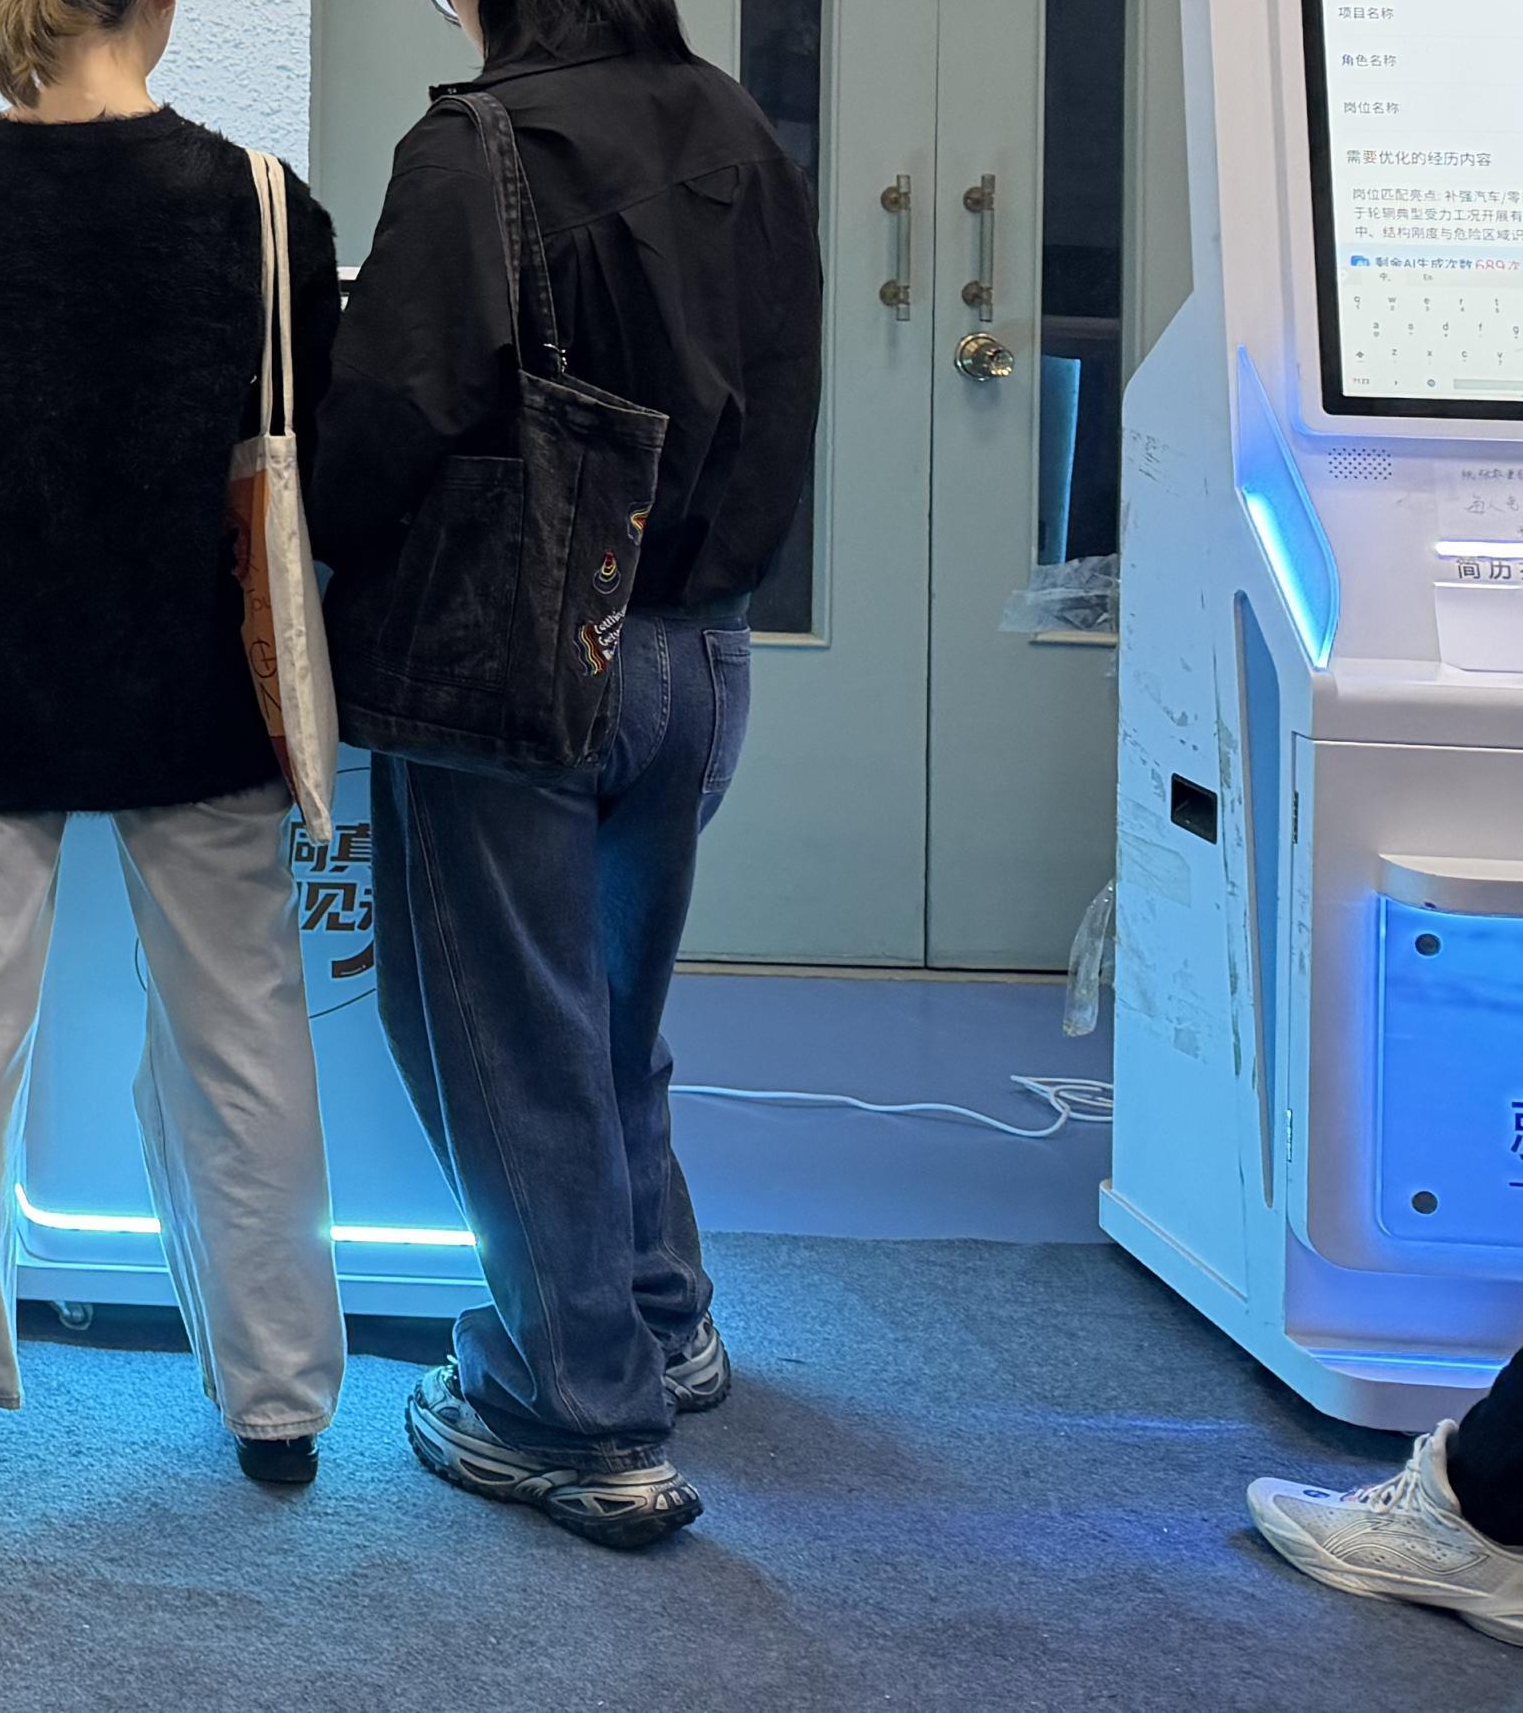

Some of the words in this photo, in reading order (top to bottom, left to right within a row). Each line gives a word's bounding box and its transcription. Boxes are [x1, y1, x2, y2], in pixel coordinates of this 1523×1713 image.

[1338, 7, 1394, 19] 项目名称
[1342, 54, 1397, 67] 角色名称
[1343, 102, 1399, 114] 岗位名称
[1347, 150, 1491, 166] 需要优化的经历内容
[1456, 558, 1523, 580] 简历
